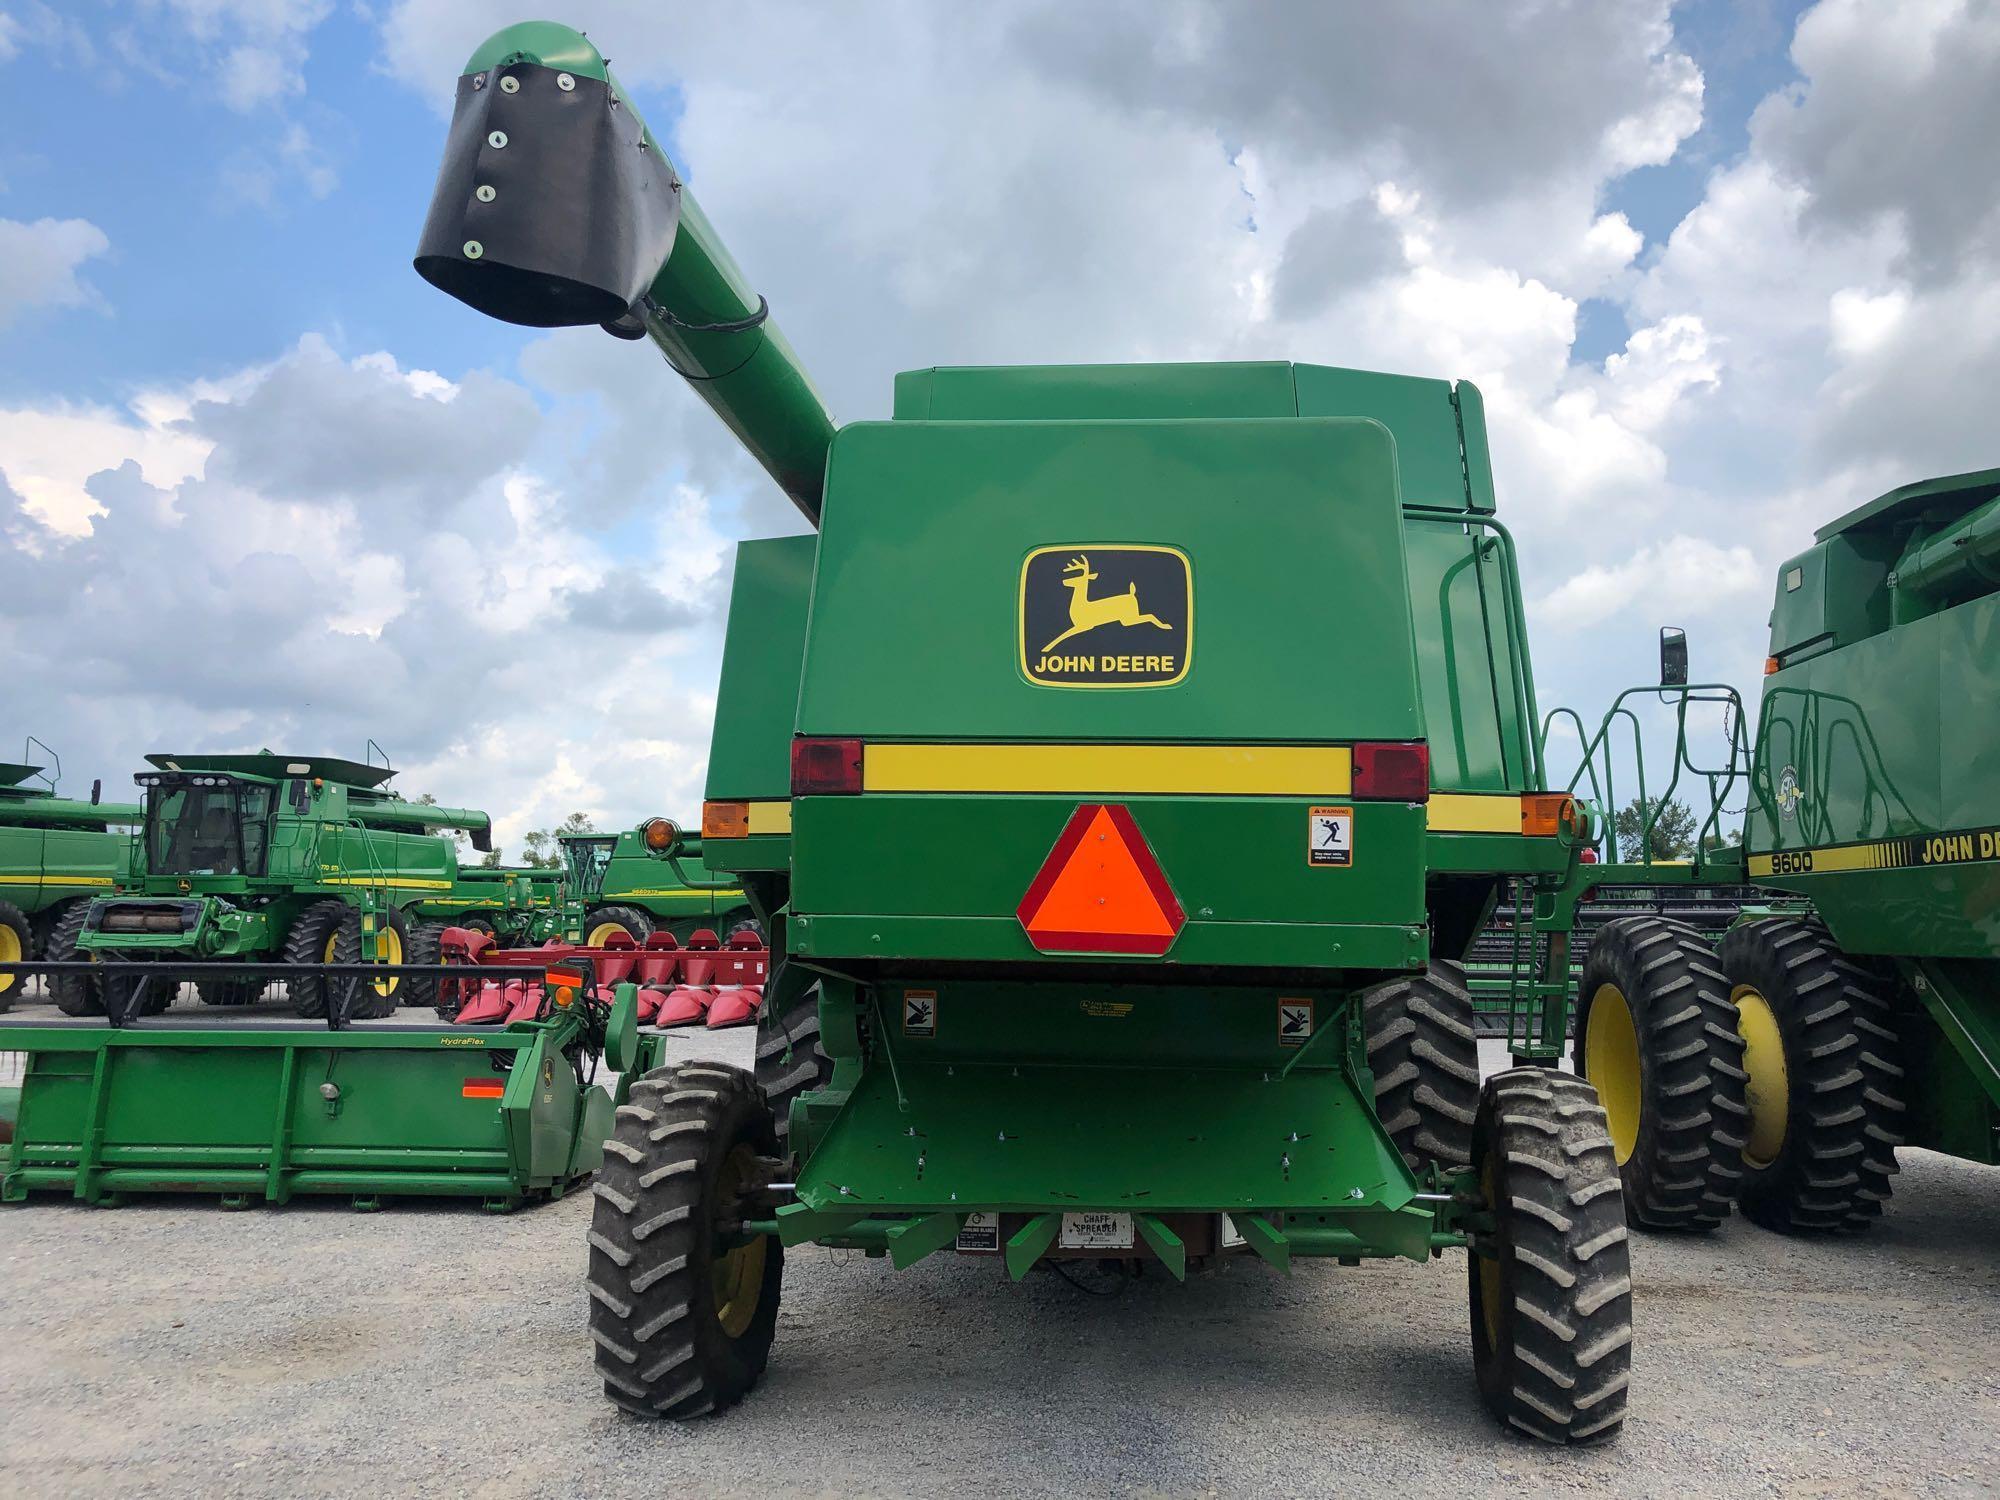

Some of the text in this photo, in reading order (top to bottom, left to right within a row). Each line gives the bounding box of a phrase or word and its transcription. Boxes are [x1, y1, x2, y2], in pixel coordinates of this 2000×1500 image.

[1035, 656, 1174, 673] JOHN DEERE
[1922, 834, 1974, 864] JOHN
[1771, 851, 1813, 875] 9600
[440, 1037, 485, 1046] HydraFlex
[1083, 1215, 1111, 1224] CHAFF
[1075, 1222, 1118, 1233] SPREADER
